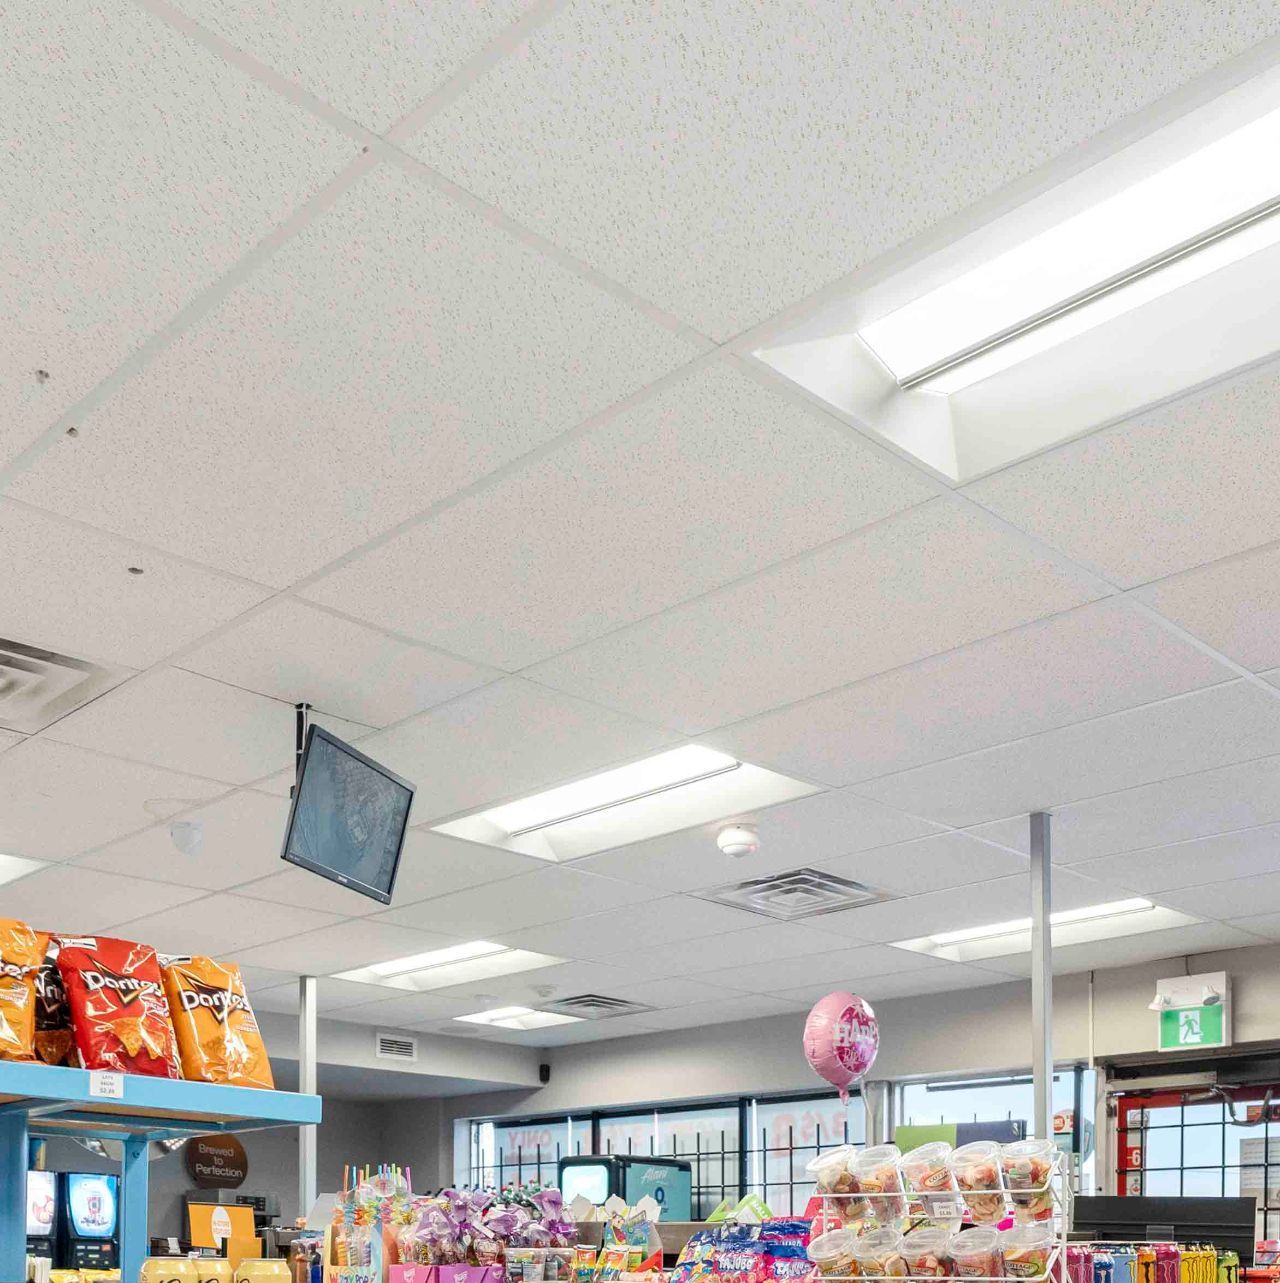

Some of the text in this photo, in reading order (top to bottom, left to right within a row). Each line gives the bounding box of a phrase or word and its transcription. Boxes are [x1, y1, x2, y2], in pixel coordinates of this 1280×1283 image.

[198, 1143, 235, 1157] Brewed
[214, 1157, 223, 1165] to
[195, 1163, 243, 1178] Perfection
